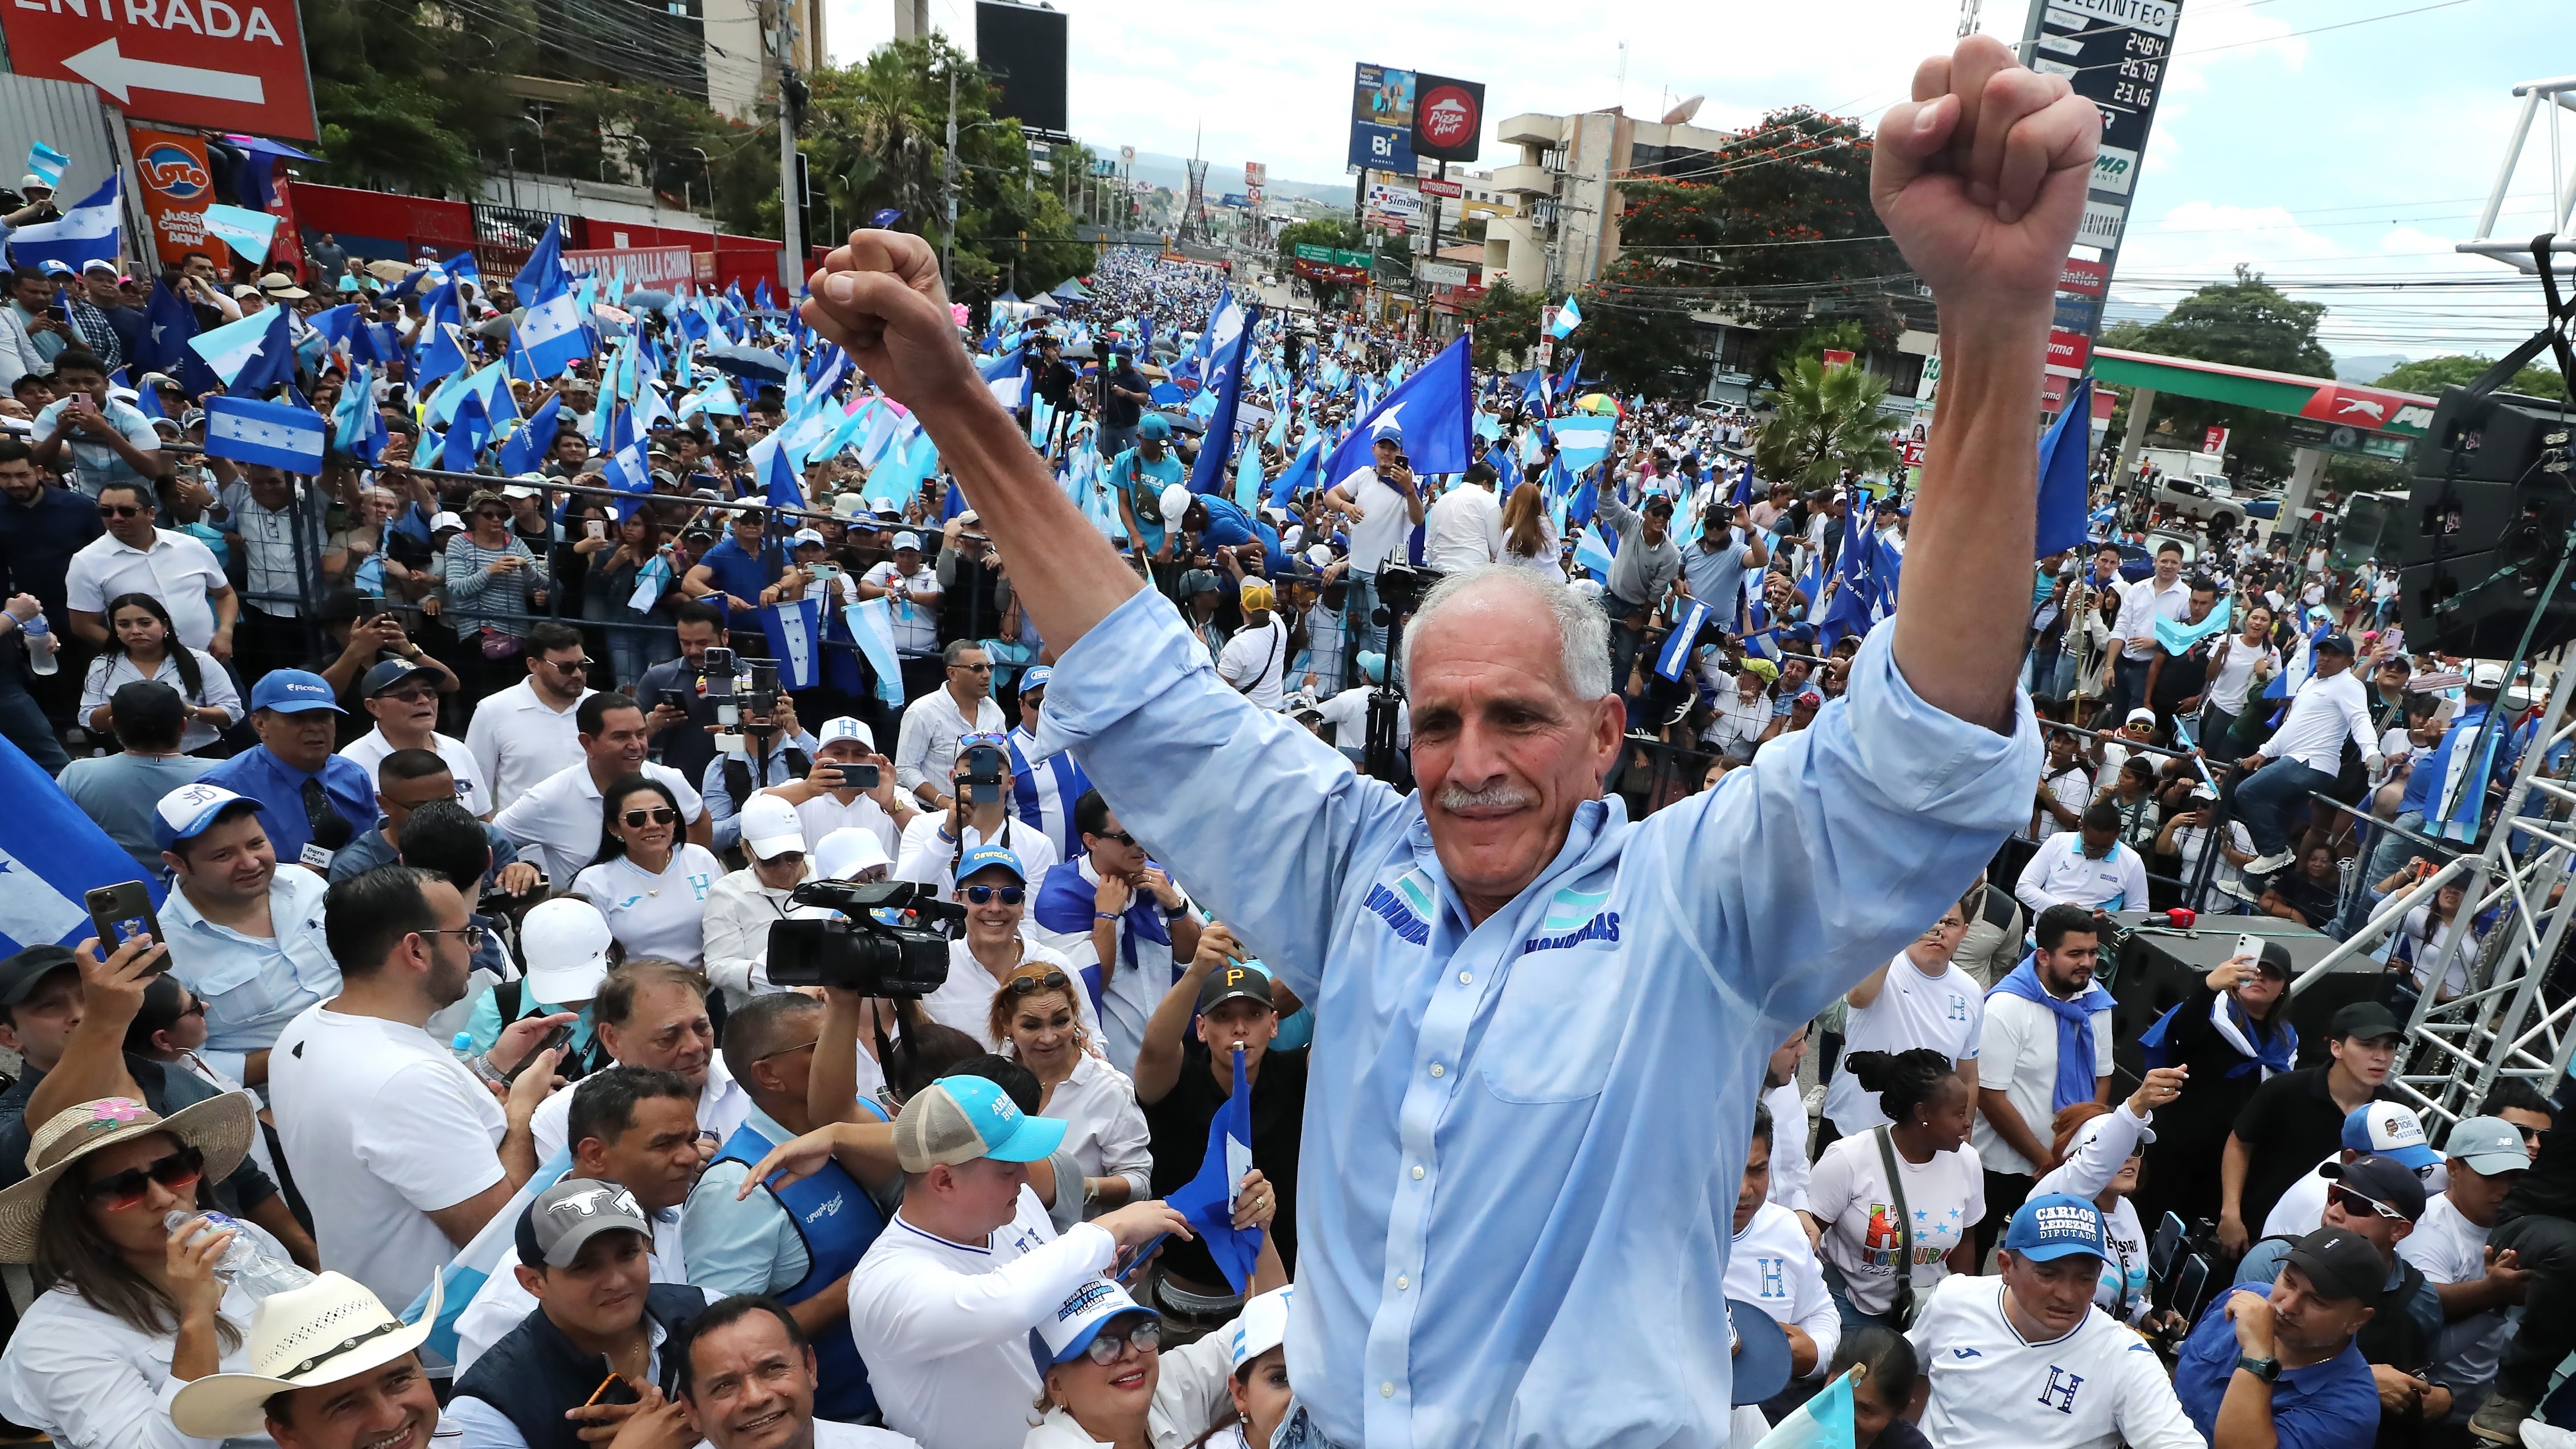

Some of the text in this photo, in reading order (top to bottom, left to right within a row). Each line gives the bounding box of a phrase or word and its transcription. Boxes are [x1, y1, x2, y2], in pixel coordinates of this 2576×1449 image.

[2053, 13, 2078, 26] Regular
[2061, 0, 2165, 27] ANTEC
[2051, 39, 2069, 50] Super
[1429, 110, 1463, 126] Pizza
[1434, 124, 1461, 135] Hut
[2093, 154, 2129, 175] MA
[1421, 180, 1460, 195] AUTOSERVICIO
[2080, 212, 2120, 237] ERICANO
[612, 252, 663, 283] MURALLA
[664, 250, 692, 279] CHINA
[1432, 267, 1466, 278] COPEMH
[2060, 269, 2100, 287] ántida
[2392, 406, 2434, 429] PU
[295, 685, 326, 693] Ficohsa
[838, 720, 858, 738] H
[302, 854, 325, 864] Parejo
[307, 847, 325, 856] Duro
[973, 850, 1014, 863] Oswaldo
[687, 874, 709, 901] H
[1363, 883, 1430, 946] HONDUR
[1227, 969, 1244, 987] P
[1949, 994, 1966, 1020] H
[2398, 1120, 2414, 1130] 106
[2395, 1130, 2418, 1139] YASSER
[2496, 1137, 2513, 1146] NB
[2035, 1206, 2096, 1224] CARLOS
[2039, 1220, 2097, 1234] LEDEZMA
[2039, 1229, 2097, 1242] DIPUTADO
[1862, 1246, 1951, 1266] HONUR
[1758, 1258, 1785, 1297] H
[1065, 1282, 1101, 1306] JUAN DIEGO
[1088, 1286, 1114, 1299] CAMBIO
[1076, 1295, 1104, 1316] ALCALDE
[2038, 1365, 2084, 1414] H
